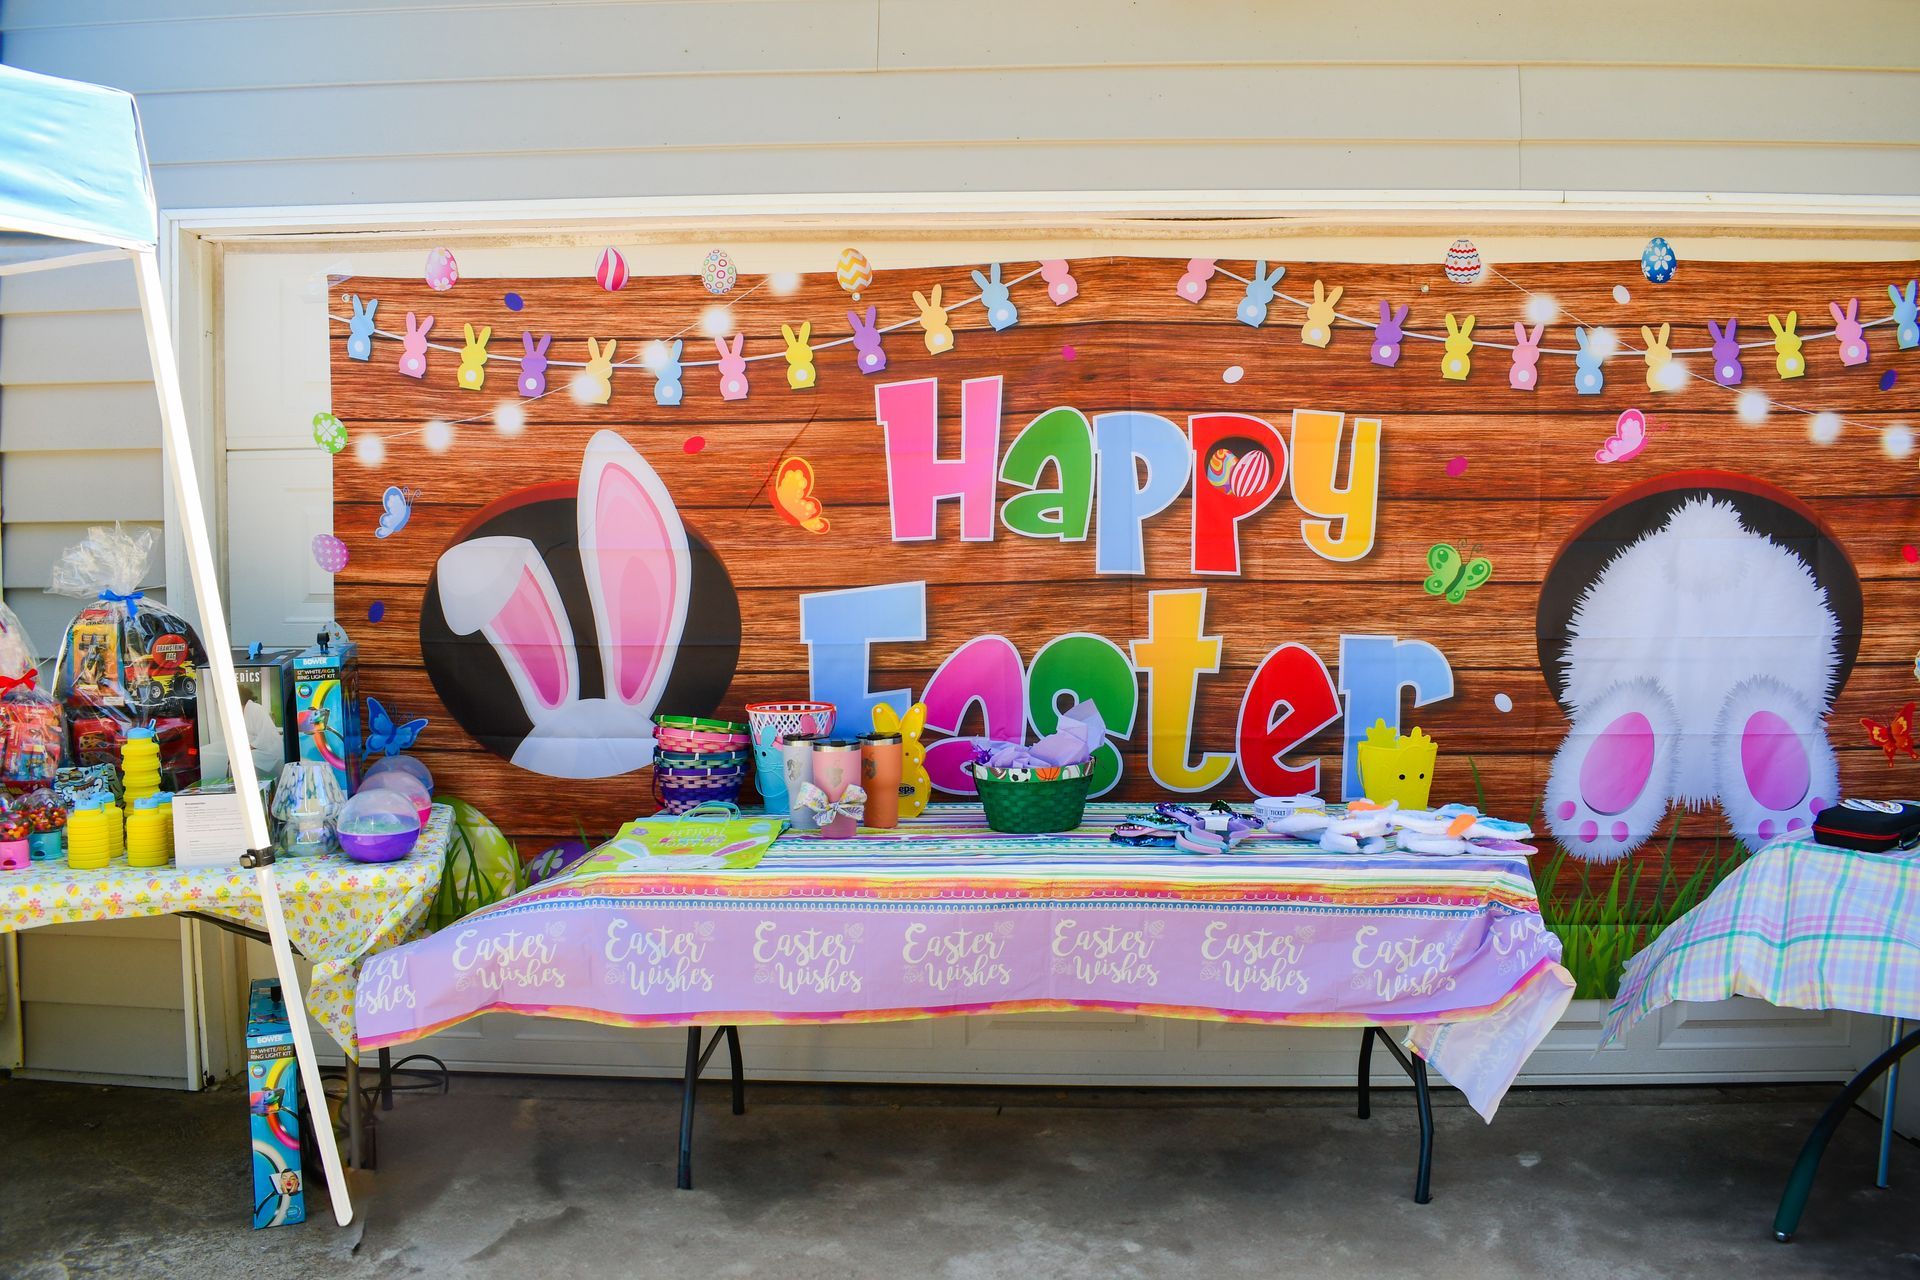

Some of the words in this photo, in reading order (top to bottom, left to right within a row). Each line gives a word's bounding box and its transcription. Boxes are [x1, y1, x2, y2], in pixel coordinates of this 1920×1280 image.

[874, 375, 1382, 575] Happy
[157, 644, 185, 652] DRAWSTRING
[799, 580, 1454, 803] Easter
[898, 784, 915, 796] eps
[452, 929, 556, 971] Easter
[605, 917, 706, 965] Easter
[753, 920, 855, 966] Easter
[902, 922, 1004, 964] Easter
[1051, 919, 1154, 959] Easter
[1201, 920, 1304, 964] Easter
[1352, 925, 1455, 973] Easter
[476, 959, 566, 990] Wishes
[627, 956, 714, 995] Wishes
[776, 958, 863, 995] Wishes
[925, 954, 1011, 990] Wishes
[1073, 952, 1159, 986] Wishes
[1222, 957, 1310, 994] Wishes
[356, 974, 416, 1014] ishes
[265, 1052, 281, 1060] LIGHT
